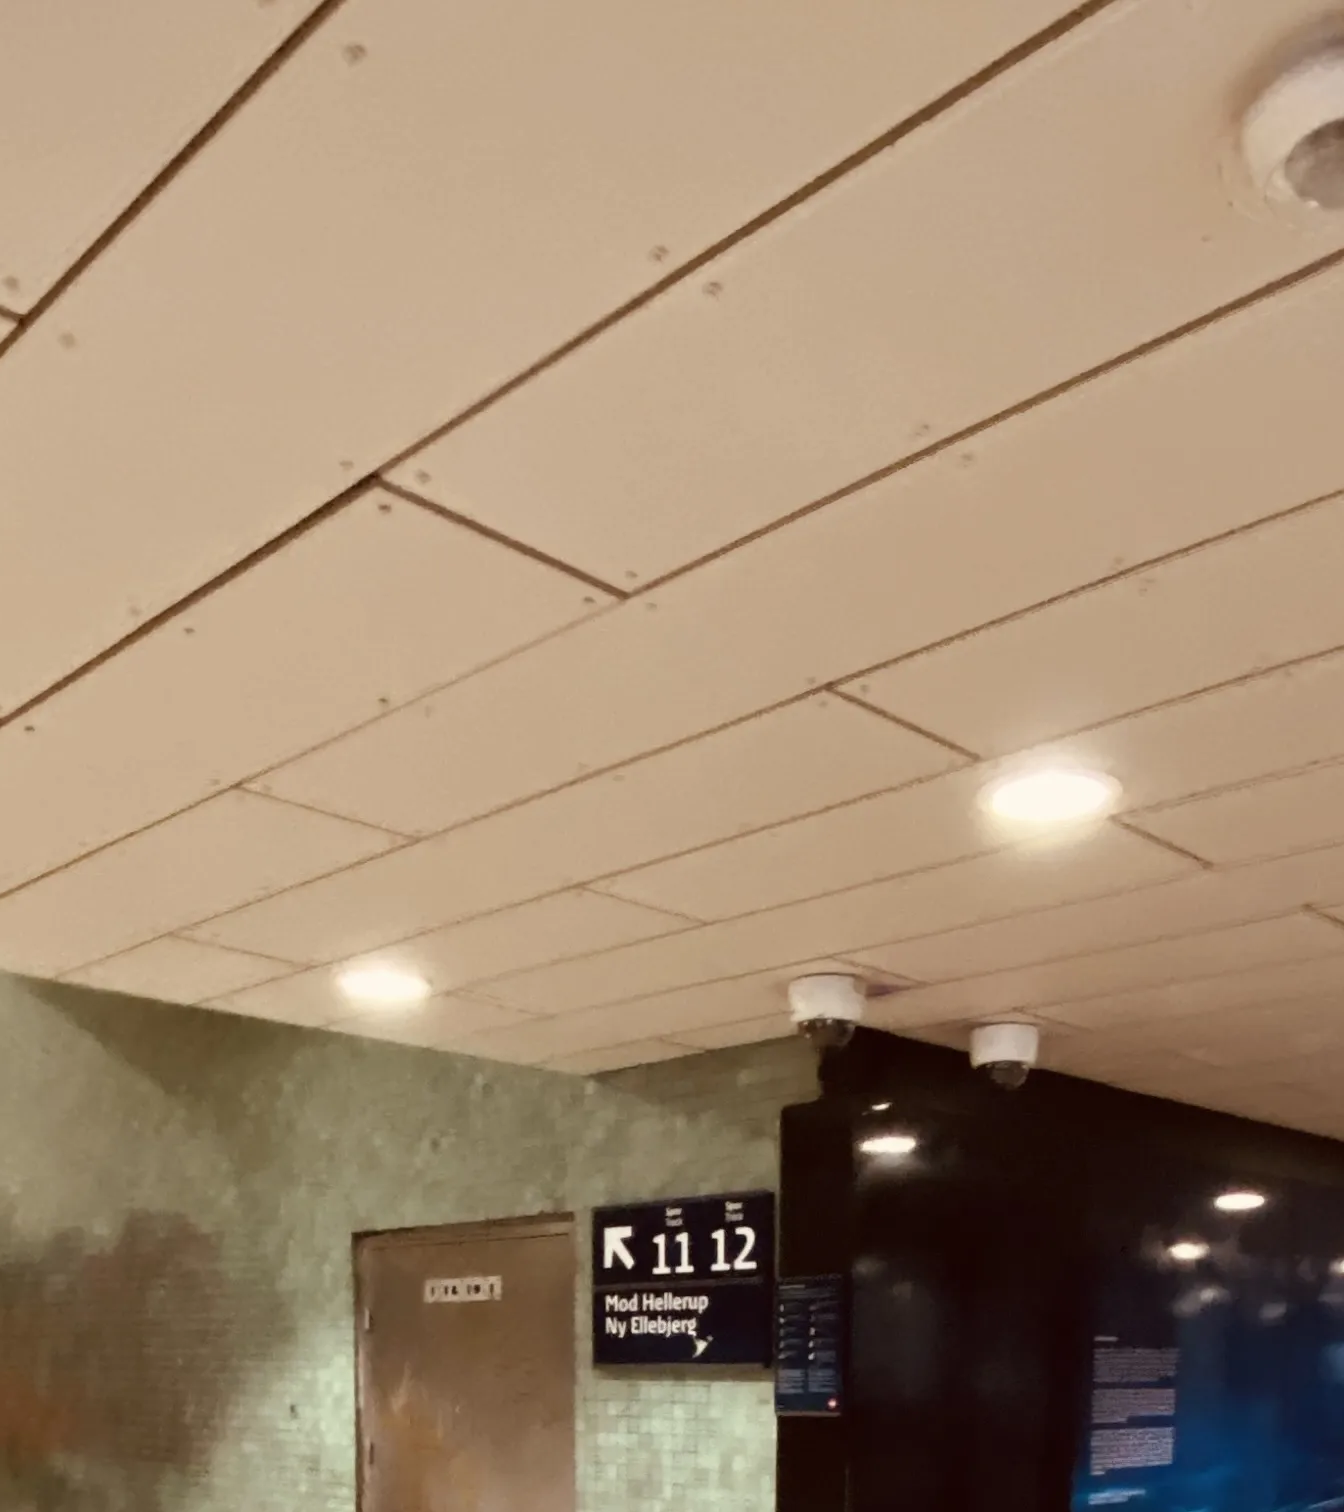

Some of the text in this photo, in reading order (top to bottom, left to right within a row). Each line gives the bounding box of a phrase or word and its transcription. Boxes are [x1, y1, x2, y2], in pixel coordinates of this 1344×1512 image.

[652, 1226, 757, 1275] 11 12
[605, 1292, 709, 1314] Mod Hellerup
[605, 1315, 698, 1338] Ny Ellebjerg
